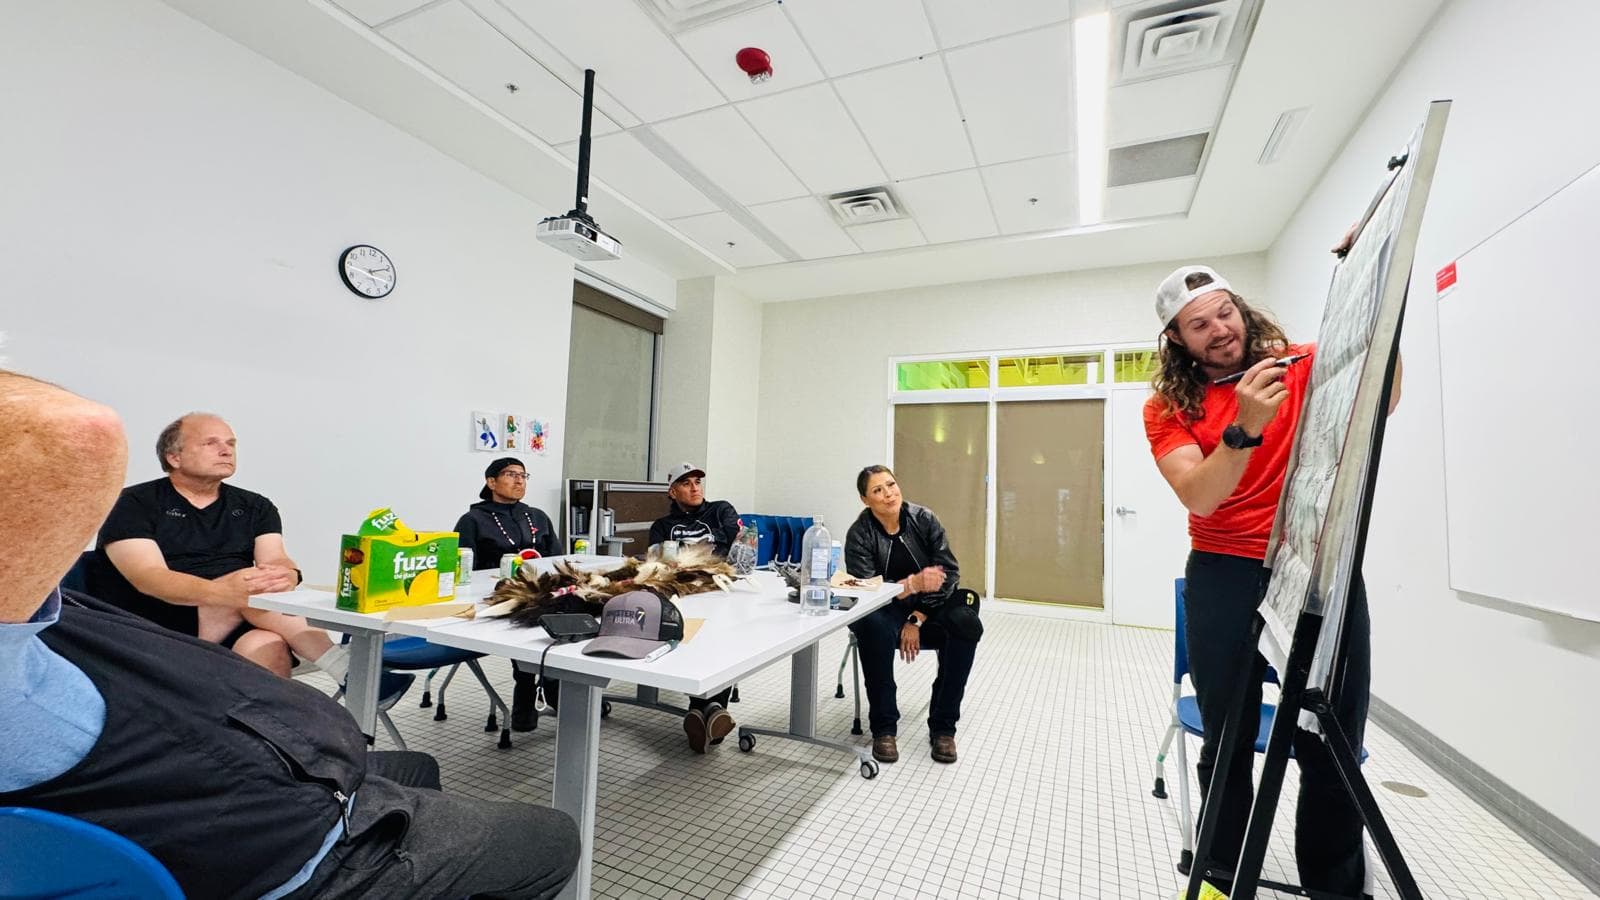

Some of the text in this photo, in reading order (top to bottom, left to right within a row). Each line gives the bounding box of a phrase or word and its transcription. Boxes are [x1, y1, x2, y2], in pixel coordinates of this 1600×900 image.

[369, 249, 377, 257] 12
[371, 512, 400, 530] fuz
[393, 551, 438, 574] fuze
[340, 567, 351, 598] fuze
[615, 616, 635, 625] ULTRA
[638, 611, 645, 621] 7
